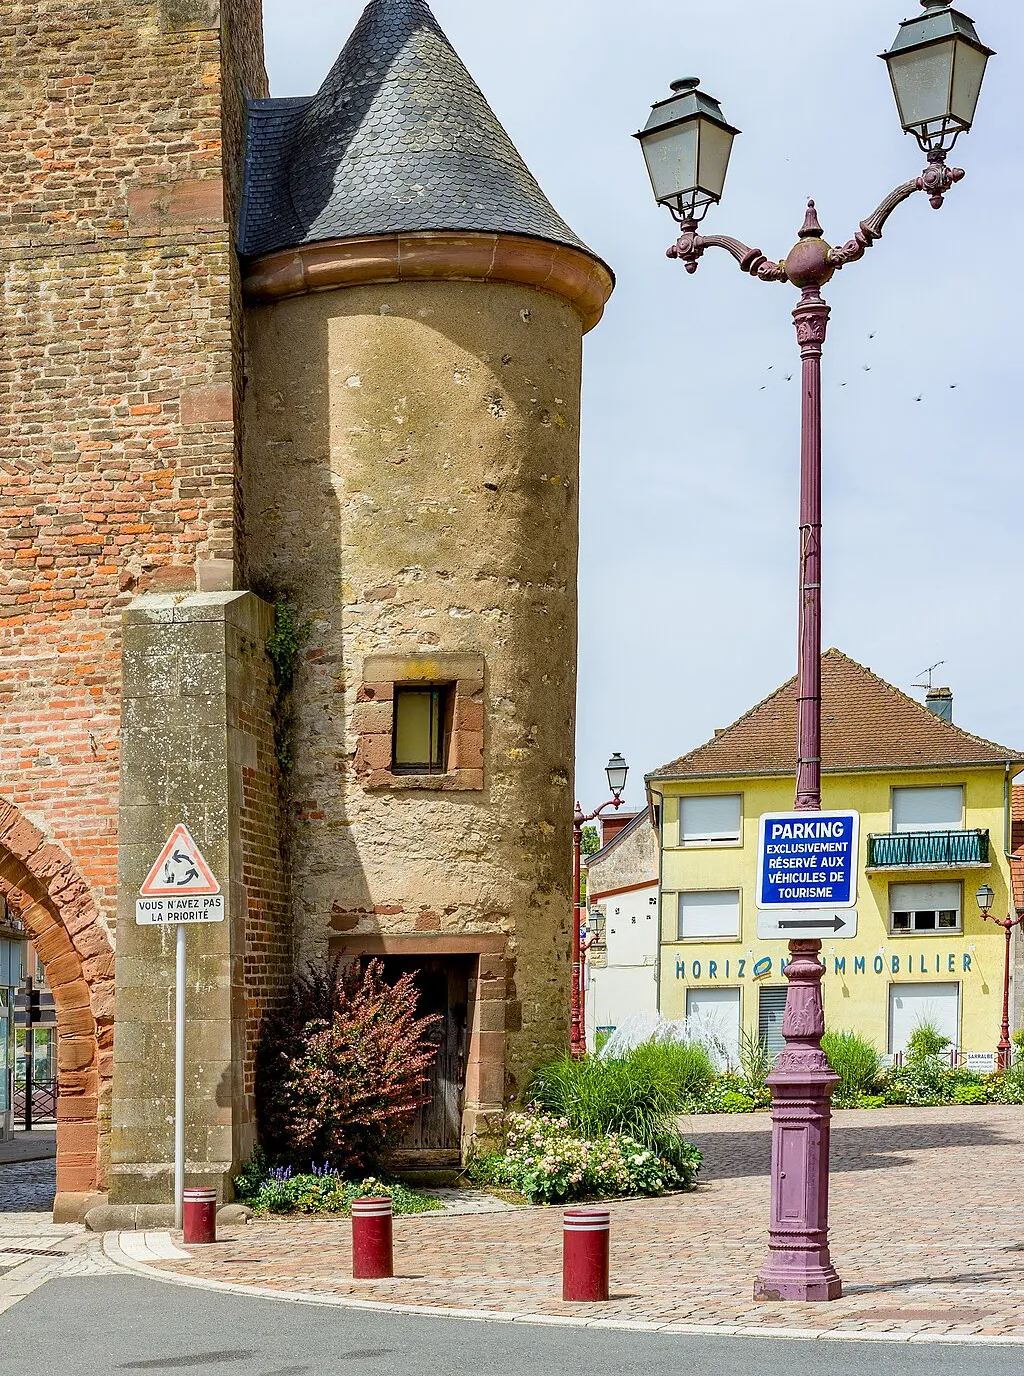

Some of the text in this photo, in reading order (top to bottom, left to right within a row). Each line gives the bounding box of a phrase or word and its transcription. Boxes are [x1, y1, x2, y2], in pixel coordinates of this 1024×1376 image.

[771, 821, 844, 839] PARKING
[766, 841, 848, 854] EXCLUSIVEMENT
[768, 854, 845, 868] RÉSERVÉ AUX
[768, 870, 845, 883] VÉHICULES DE
[778, 886, 833, 898] TOURISME
[139, 898, 221, 910] VOUS N'AVEZ PAS
[151, 909, 209, 922] LA PRIORITÉ
